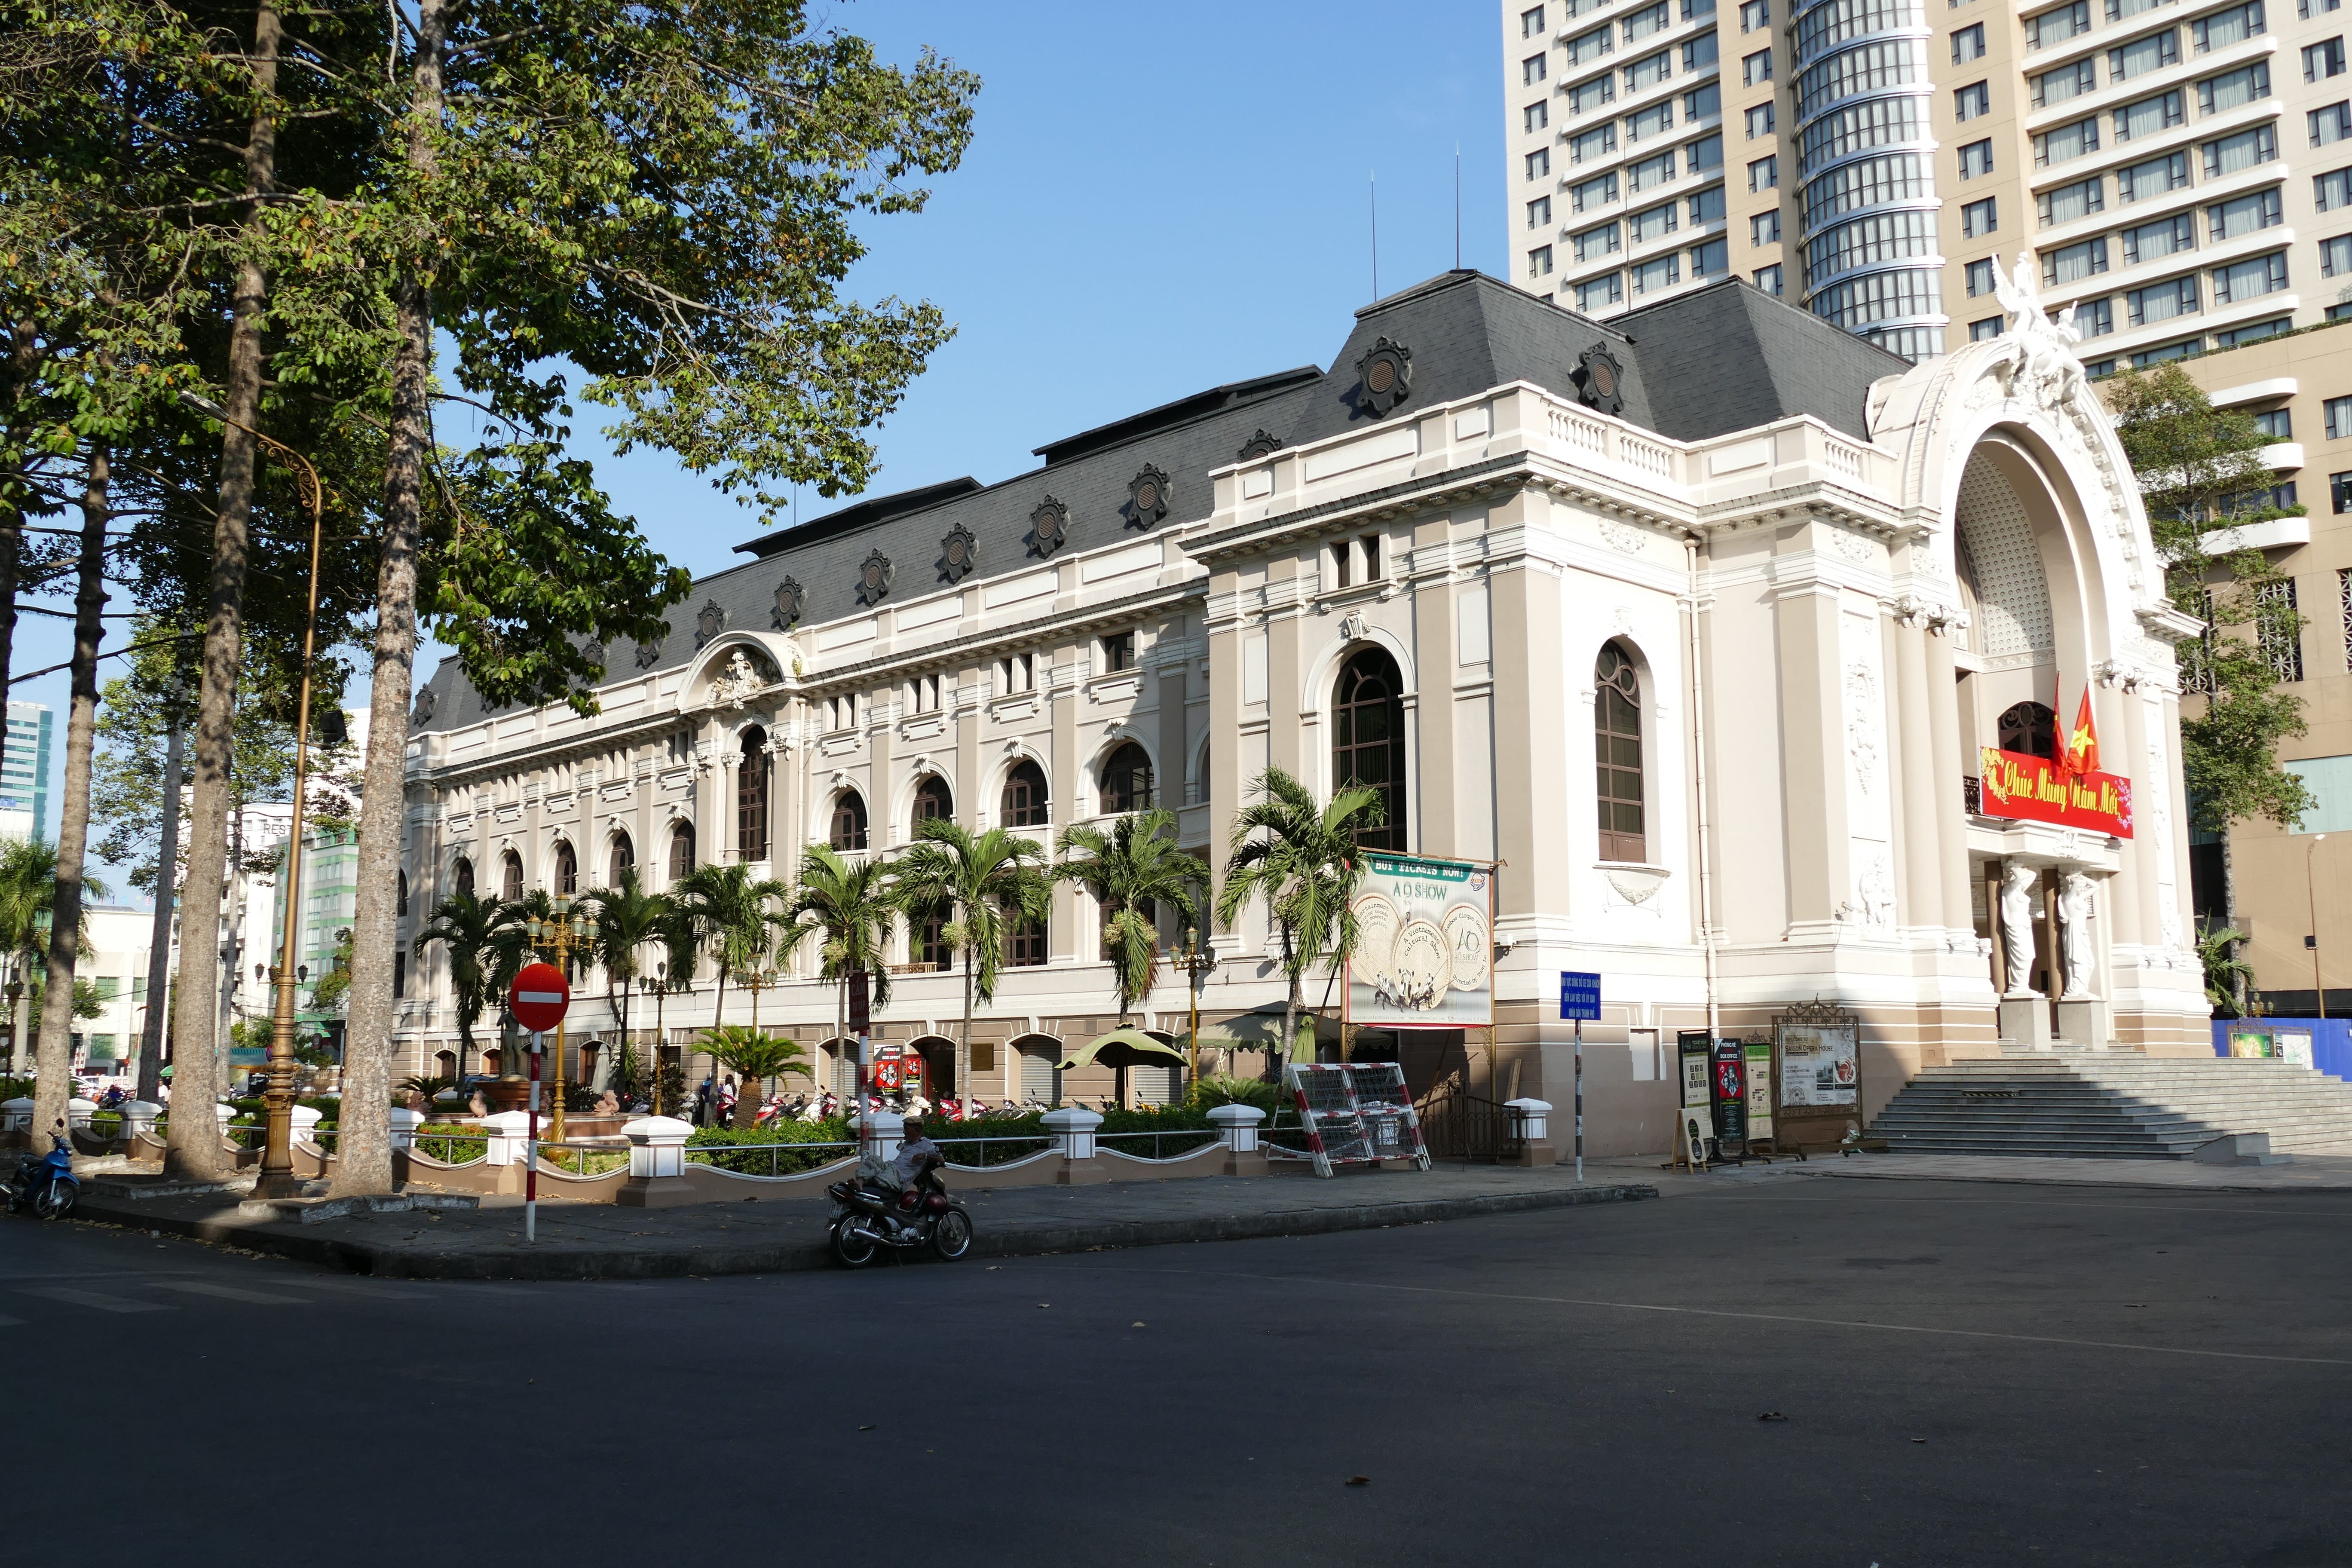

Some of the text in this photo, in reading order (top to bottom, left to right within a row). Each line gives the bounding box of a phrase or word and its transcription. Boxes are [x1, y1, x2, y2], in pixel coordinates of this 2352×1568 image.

[2004, 760, 2119, 816] Chúc Mừng Năm Mới
[1375, 860, 1464, 878] BUY TICKETS NOW!
[1393, 881, 1448, 900] A O SHOW
[1408, 927, 1440, 944] Vietnamese
[1444, 916, 1458, 934] Bamboo
[1476, 920, 1485, 937] Genre
[1404, 936, 1428, 956] Cultural
[851, 977, 866, 996] CẤM
[1452, 974, 1471, 986] Directed
